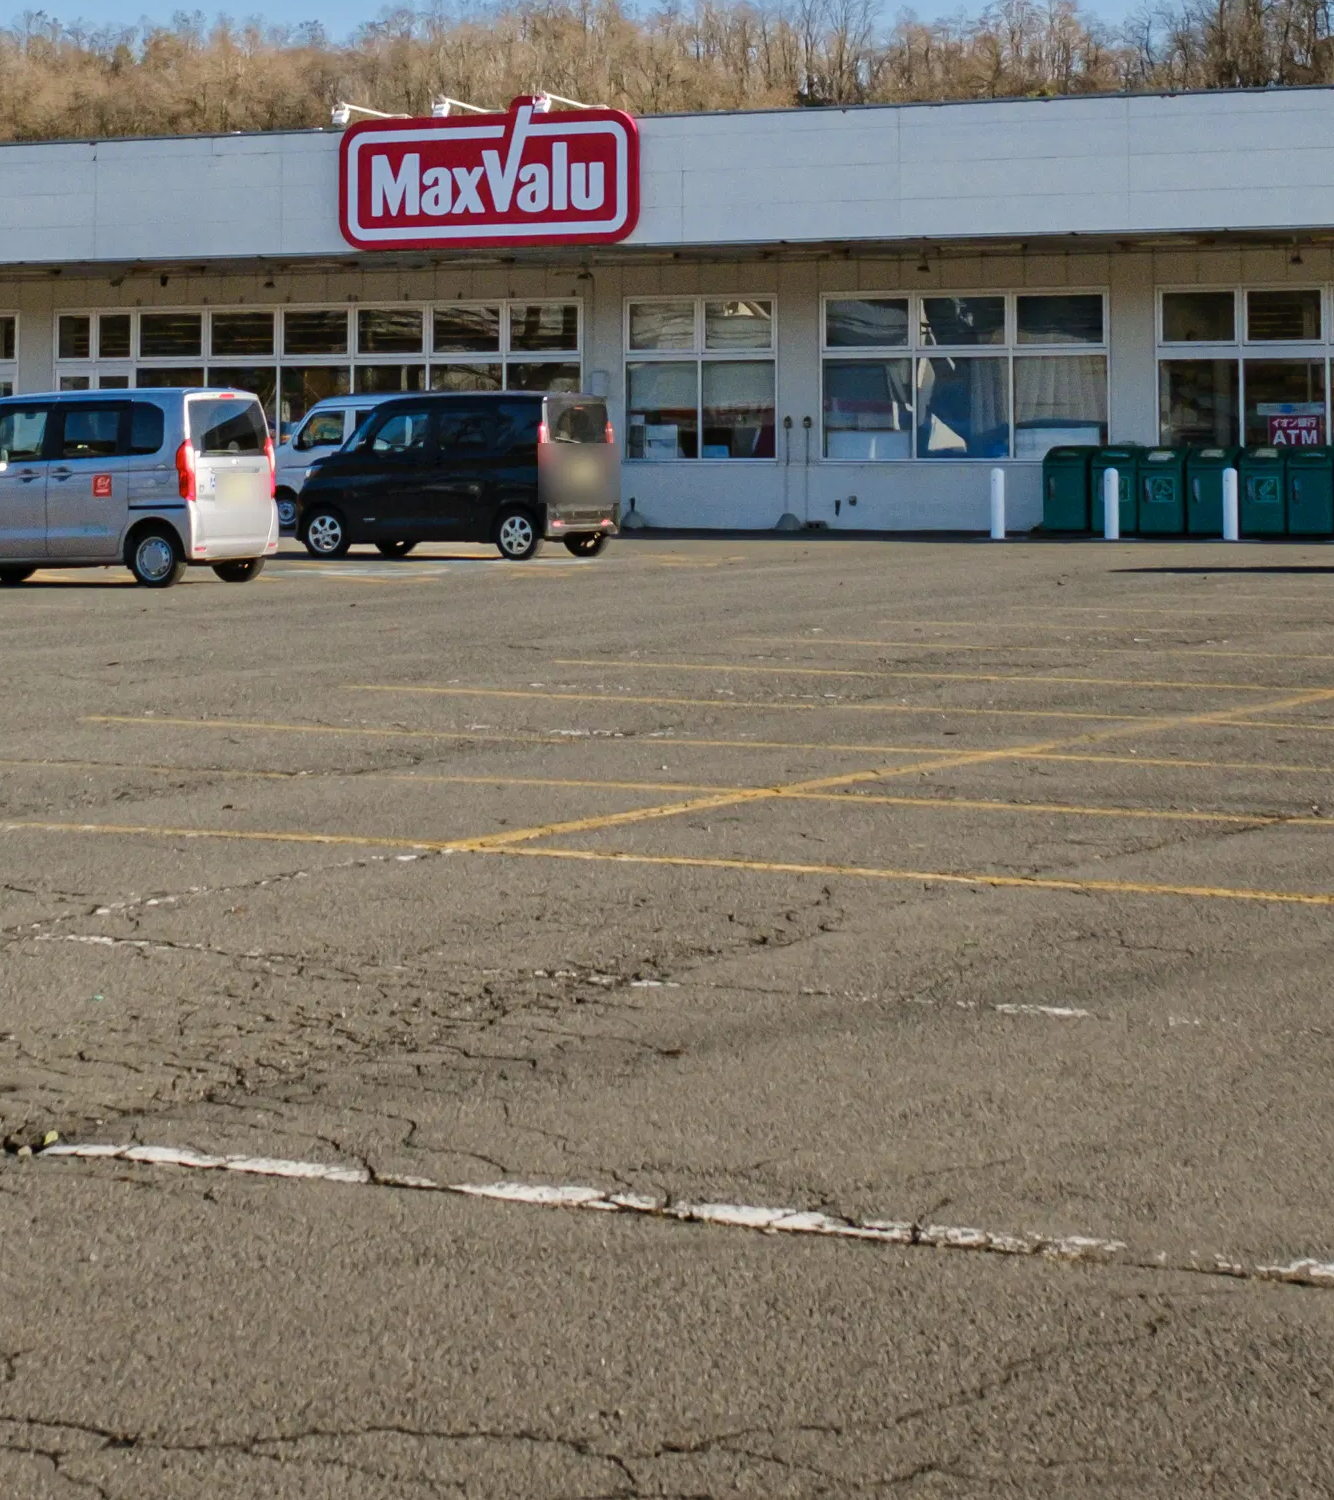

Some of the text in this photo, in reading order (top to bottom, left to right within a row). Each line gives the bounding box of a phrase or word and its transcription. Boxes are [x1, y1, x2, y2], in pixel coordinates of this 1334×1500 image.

[370, 105, 605, 218] MaxValu
[1271, 417, 1317, 428] イオン銀行
[1272, 429, 1318, 445] ATM
